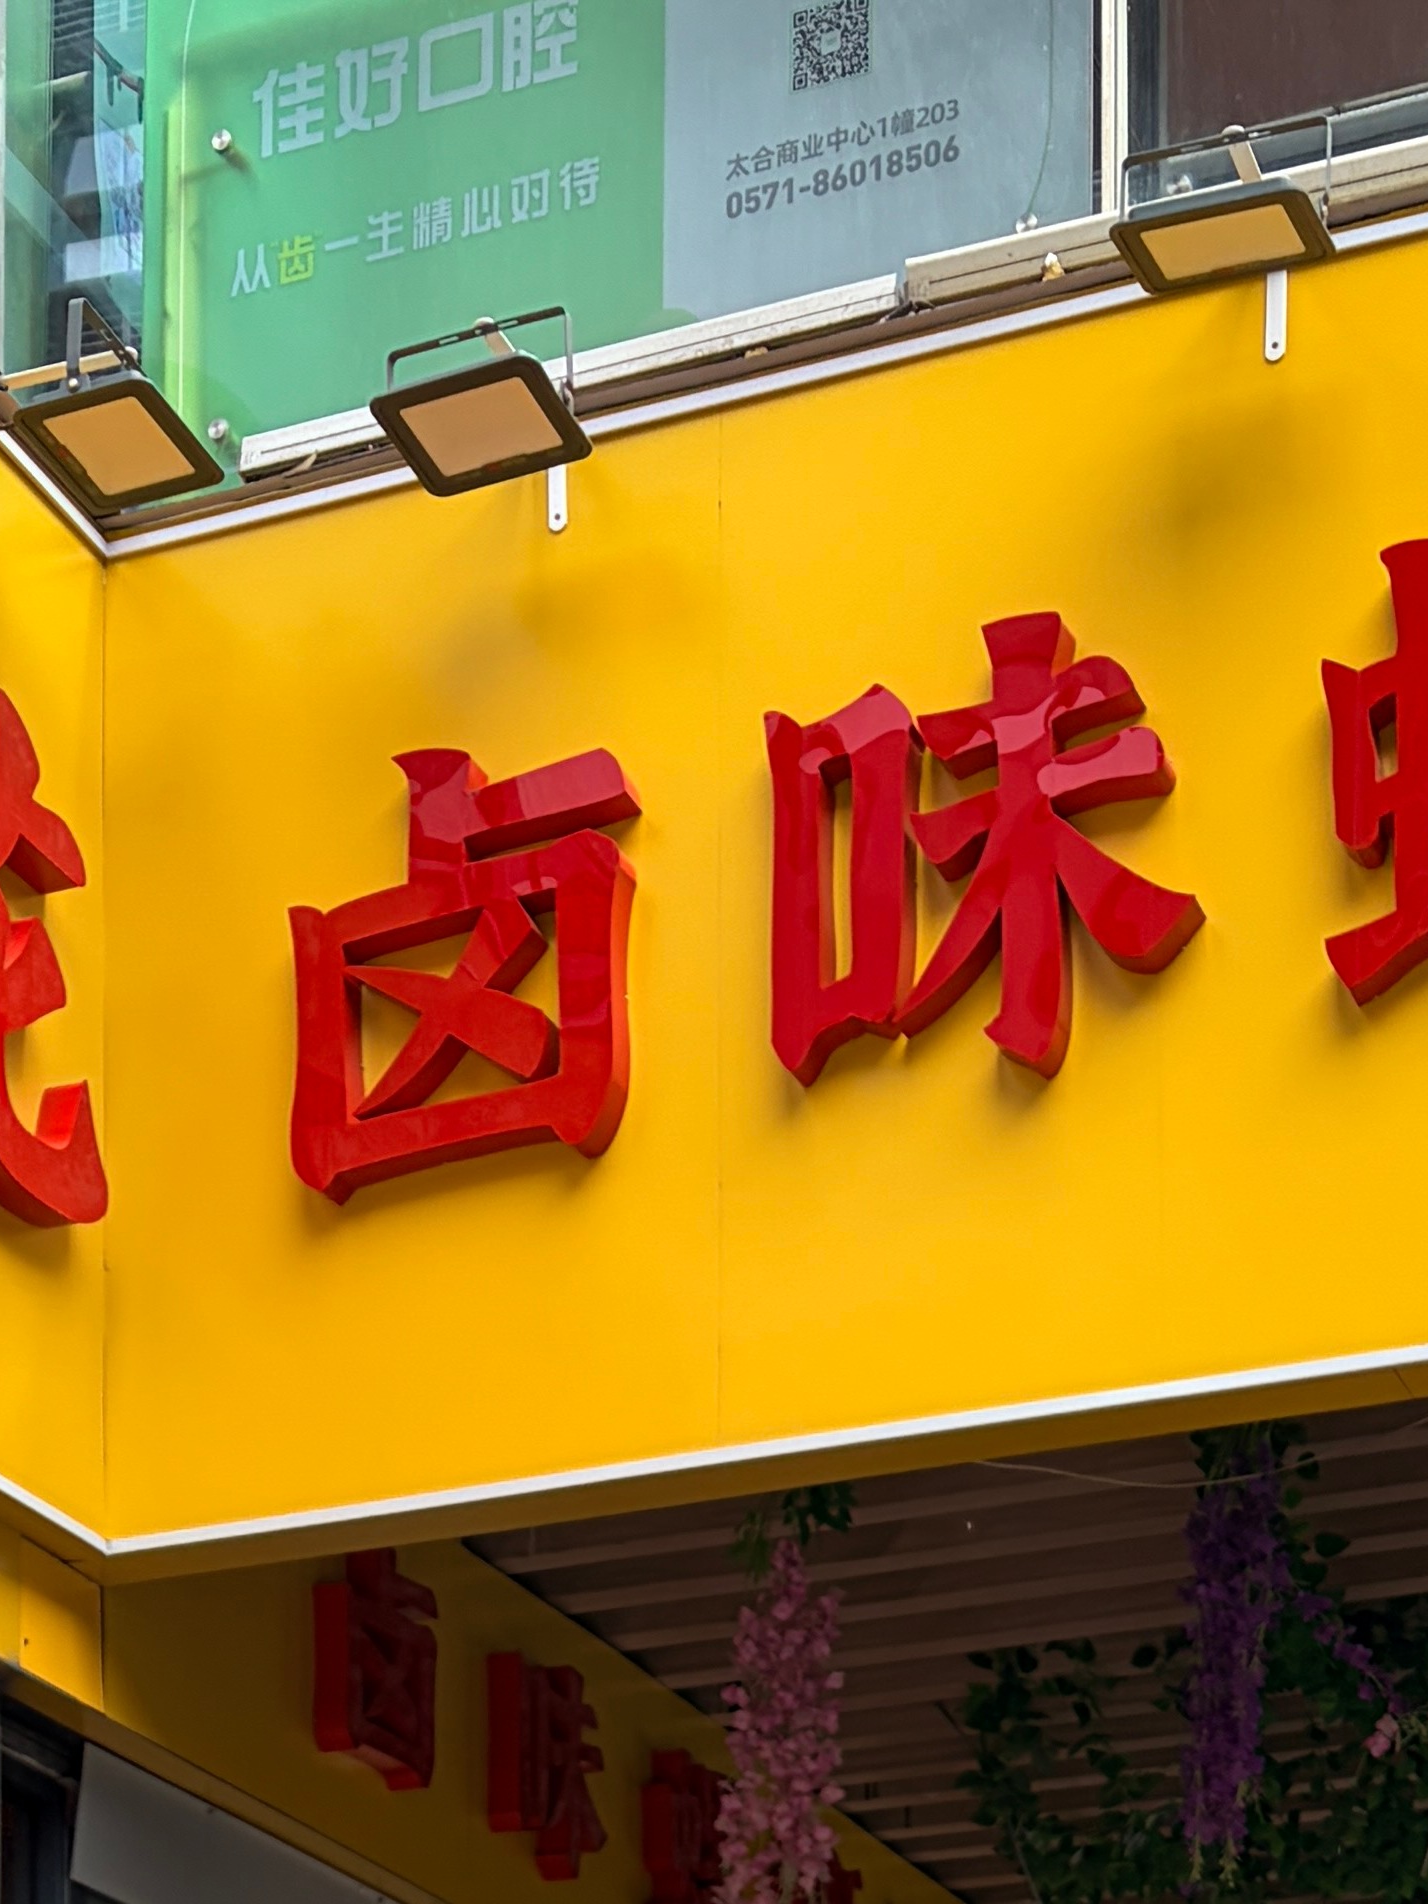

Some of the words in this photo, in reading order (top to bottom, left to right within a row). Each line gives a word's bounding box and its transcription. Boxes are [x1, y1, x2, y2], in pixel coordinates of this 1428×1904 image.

[252, 0, 579, 160] 佳好口腔
[724, 135, 961, 220] 0571-86018506
[725, 98, 960, 181] 太合商业中心1幢203
